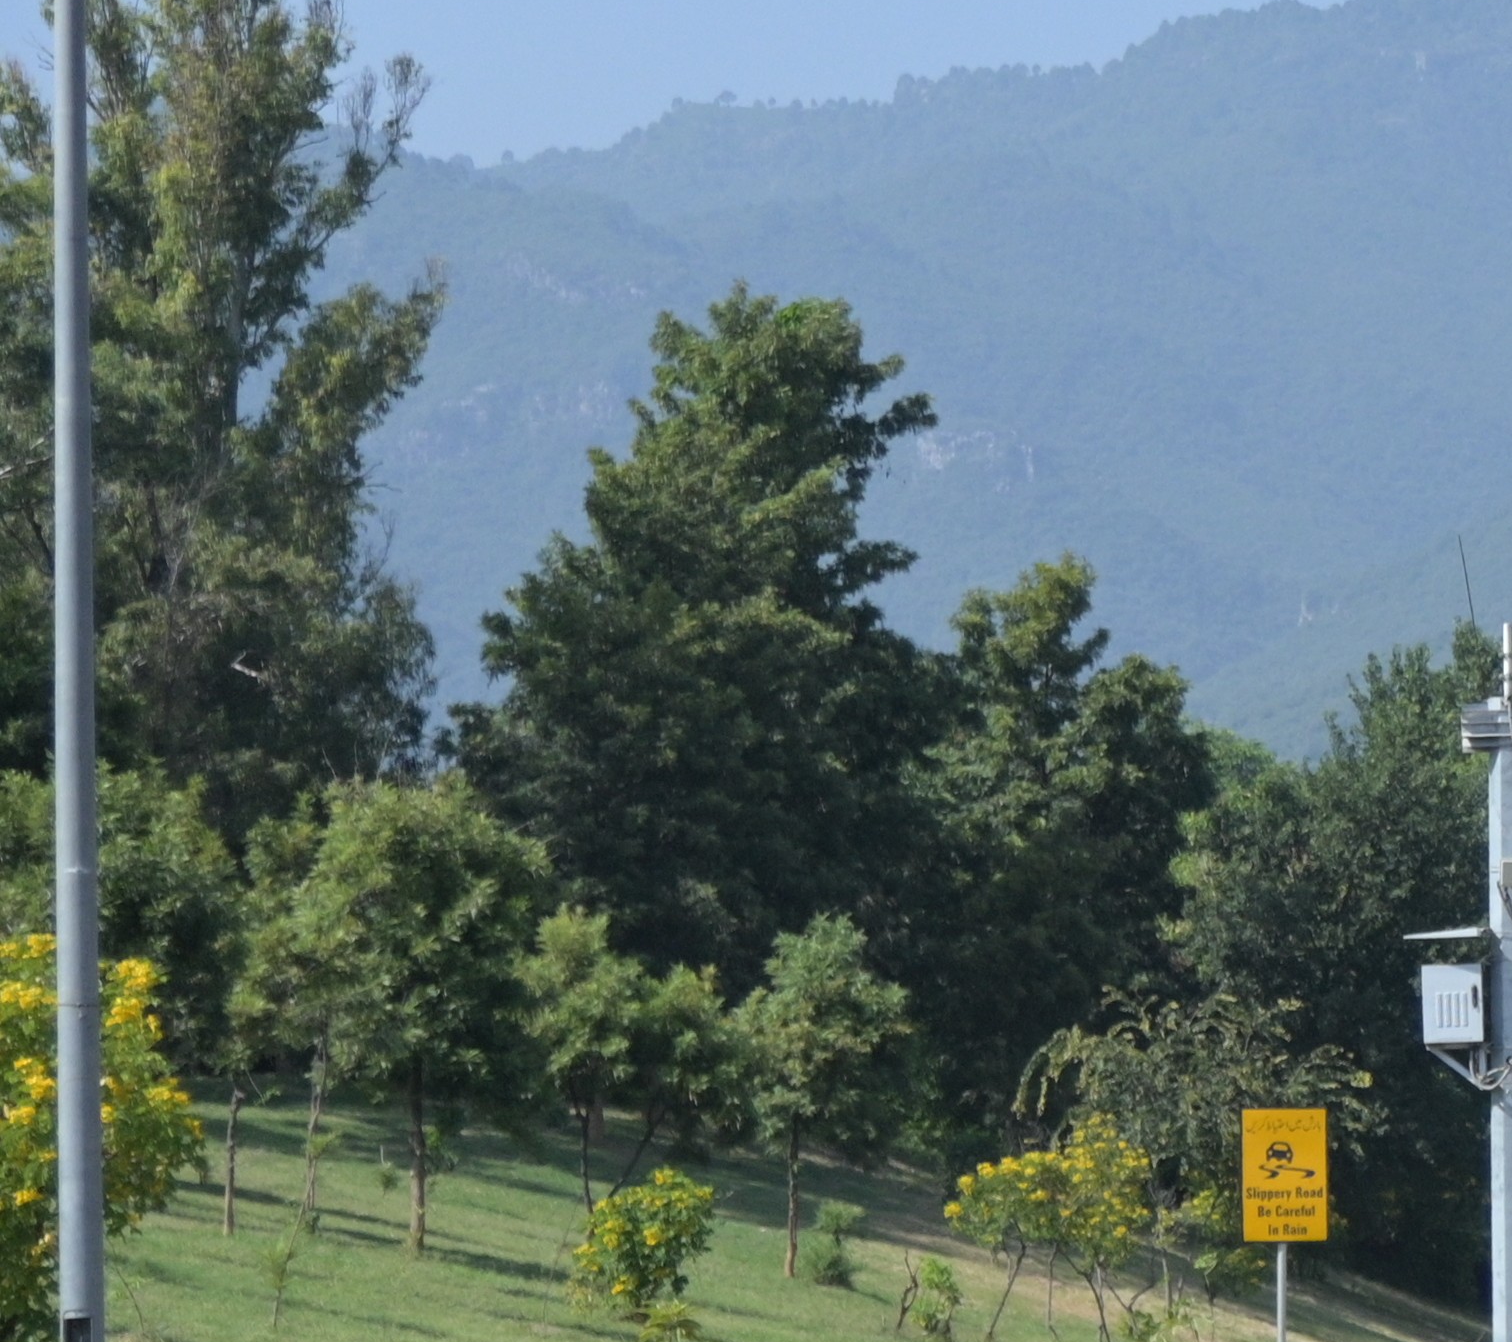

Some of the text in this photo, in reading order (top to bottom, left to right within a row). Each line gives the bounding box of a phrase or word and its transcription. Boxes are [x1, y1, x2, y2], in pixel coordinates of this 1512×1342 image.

[1245, 1186, 1323, 1202] Slippery Road
[1257, 1205, 1316, 1217] Be Careful
[1268, 1223, 1308, 1235] In Rain
